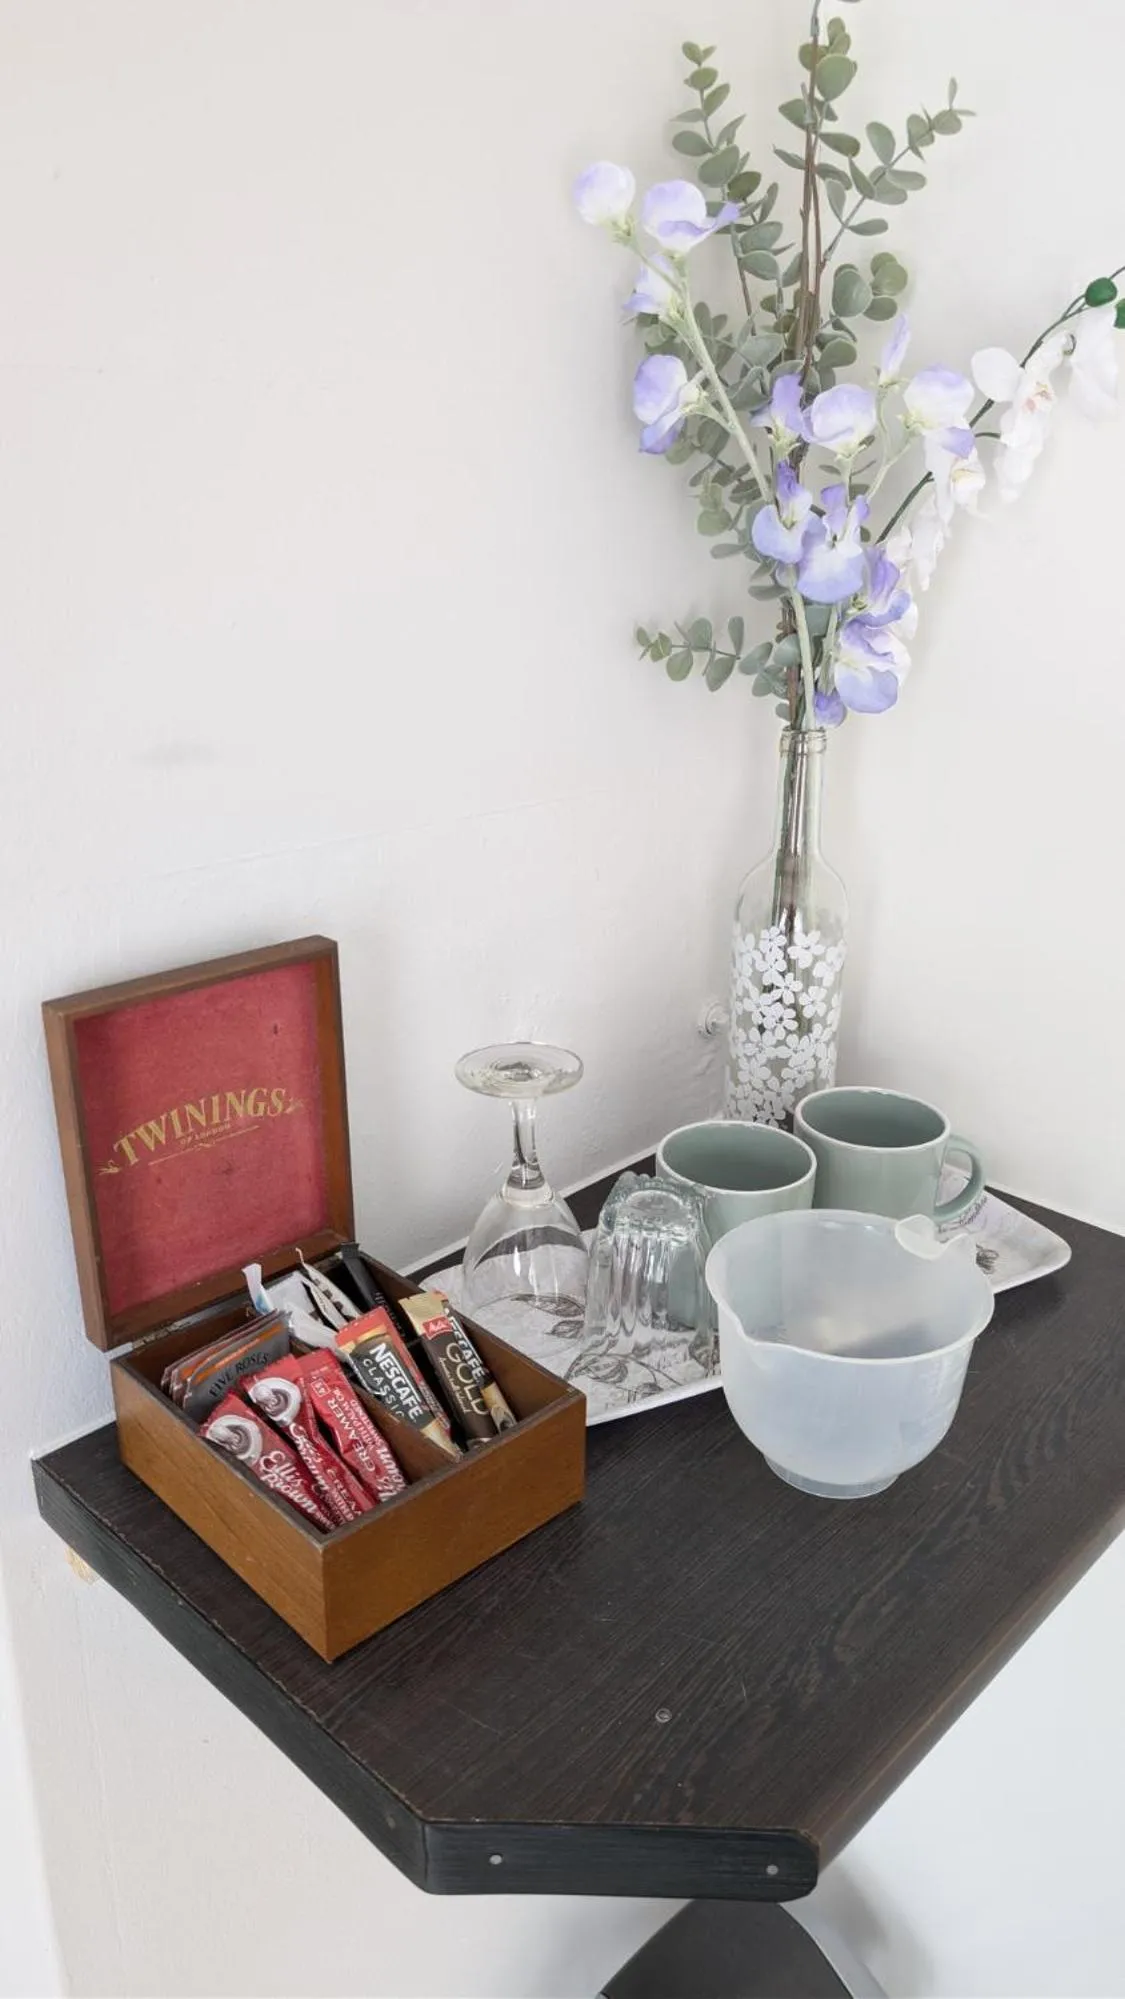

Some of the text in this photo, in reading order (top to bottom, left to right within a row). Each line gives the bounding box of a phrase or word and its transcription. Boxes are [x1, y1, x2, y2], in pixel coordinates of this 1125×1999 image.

[113, 1088, 286, 1165] TWININGS
[209, 1352, 270, 1398] FIVE ROSES
[446, 1342, 489, 1416] GOLD
[260, 1450, 304, 1486] Ellis
[327, 1398, 376, 1473] CREAMER
